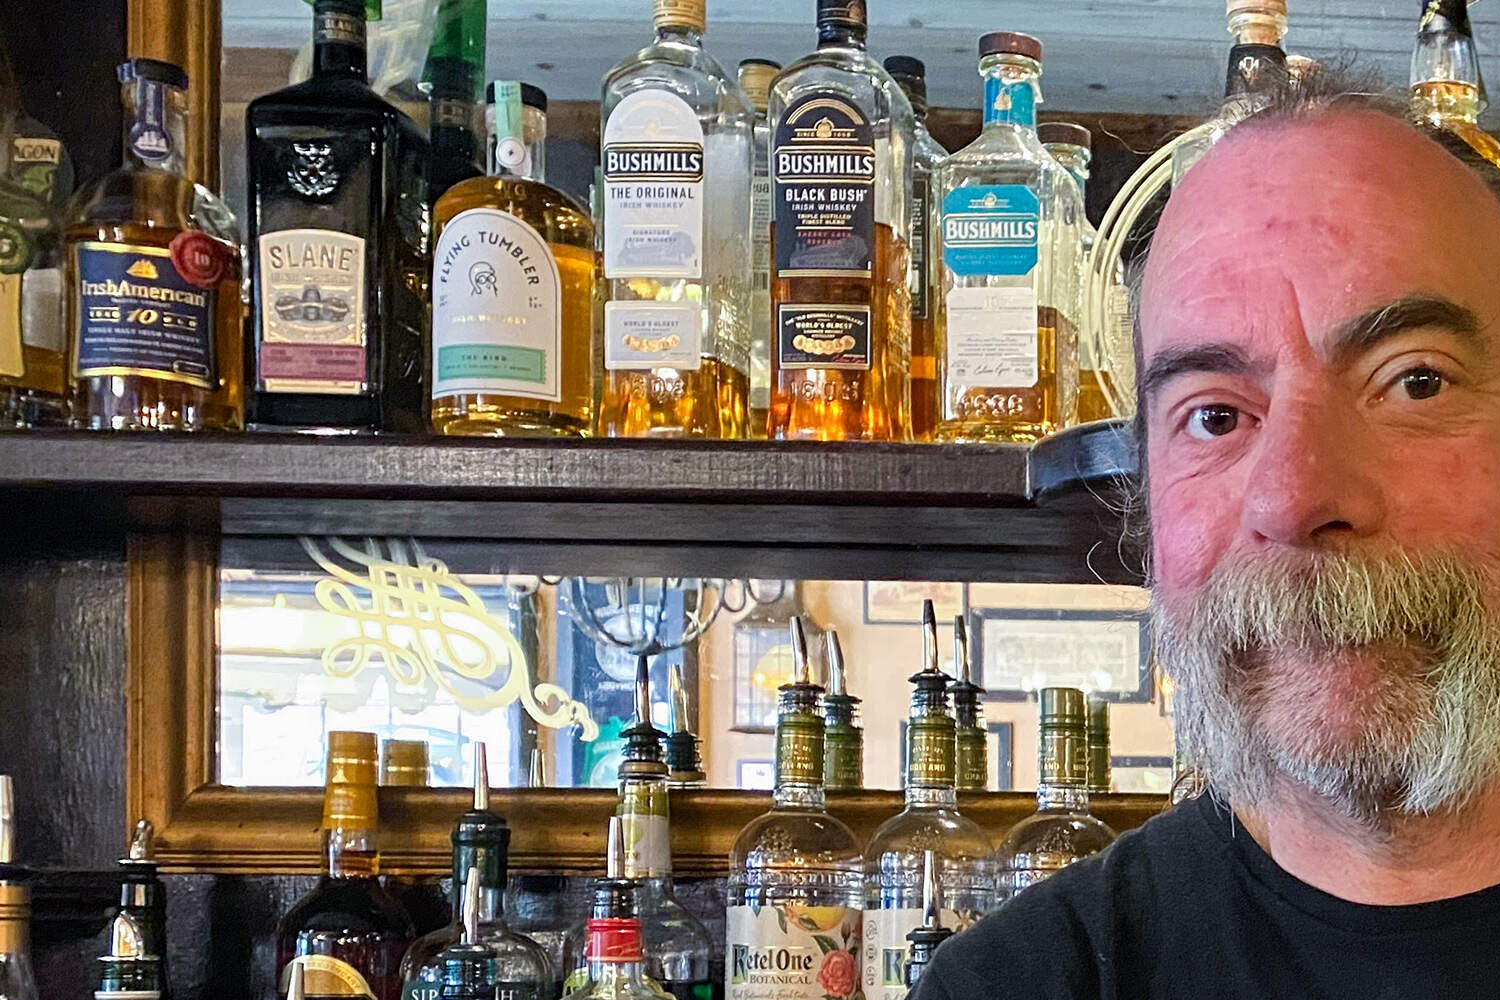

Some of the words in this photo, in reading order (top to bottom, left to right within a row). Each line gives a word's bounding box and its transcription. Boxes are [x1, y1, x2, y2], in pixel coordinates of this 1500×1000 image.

[607, 151, 701, 172] BUSHMILLS
[778, 153, 874, 175] BUSHMILLS
[610, 187, 632, 199] THE
[636, 187, 695, 199] ORIGINAL
[785, 188, 826, 202] BLACK
[830, 188, 864, 202] BUSH
[619, 201, 643, 209] IRISH
[645, 201, 685, 209] WHISKEY
[791, 203, 815, 211] IRISH
[817, 203, 857, 211] WHISKEY
[945, 220, 1036, 240] BUSHMILLS
[269, 242, 351, 271] SLANE
[440, 235, 471, 283] FLYING
[478, 230, 540, 286] TUMBLER
[126, 308, 159, 325] 10
[732, 944, 774, 980] Ketel
[775, 948, 813, 971] One
[749, 974, 812, 985] BOTANICAL
